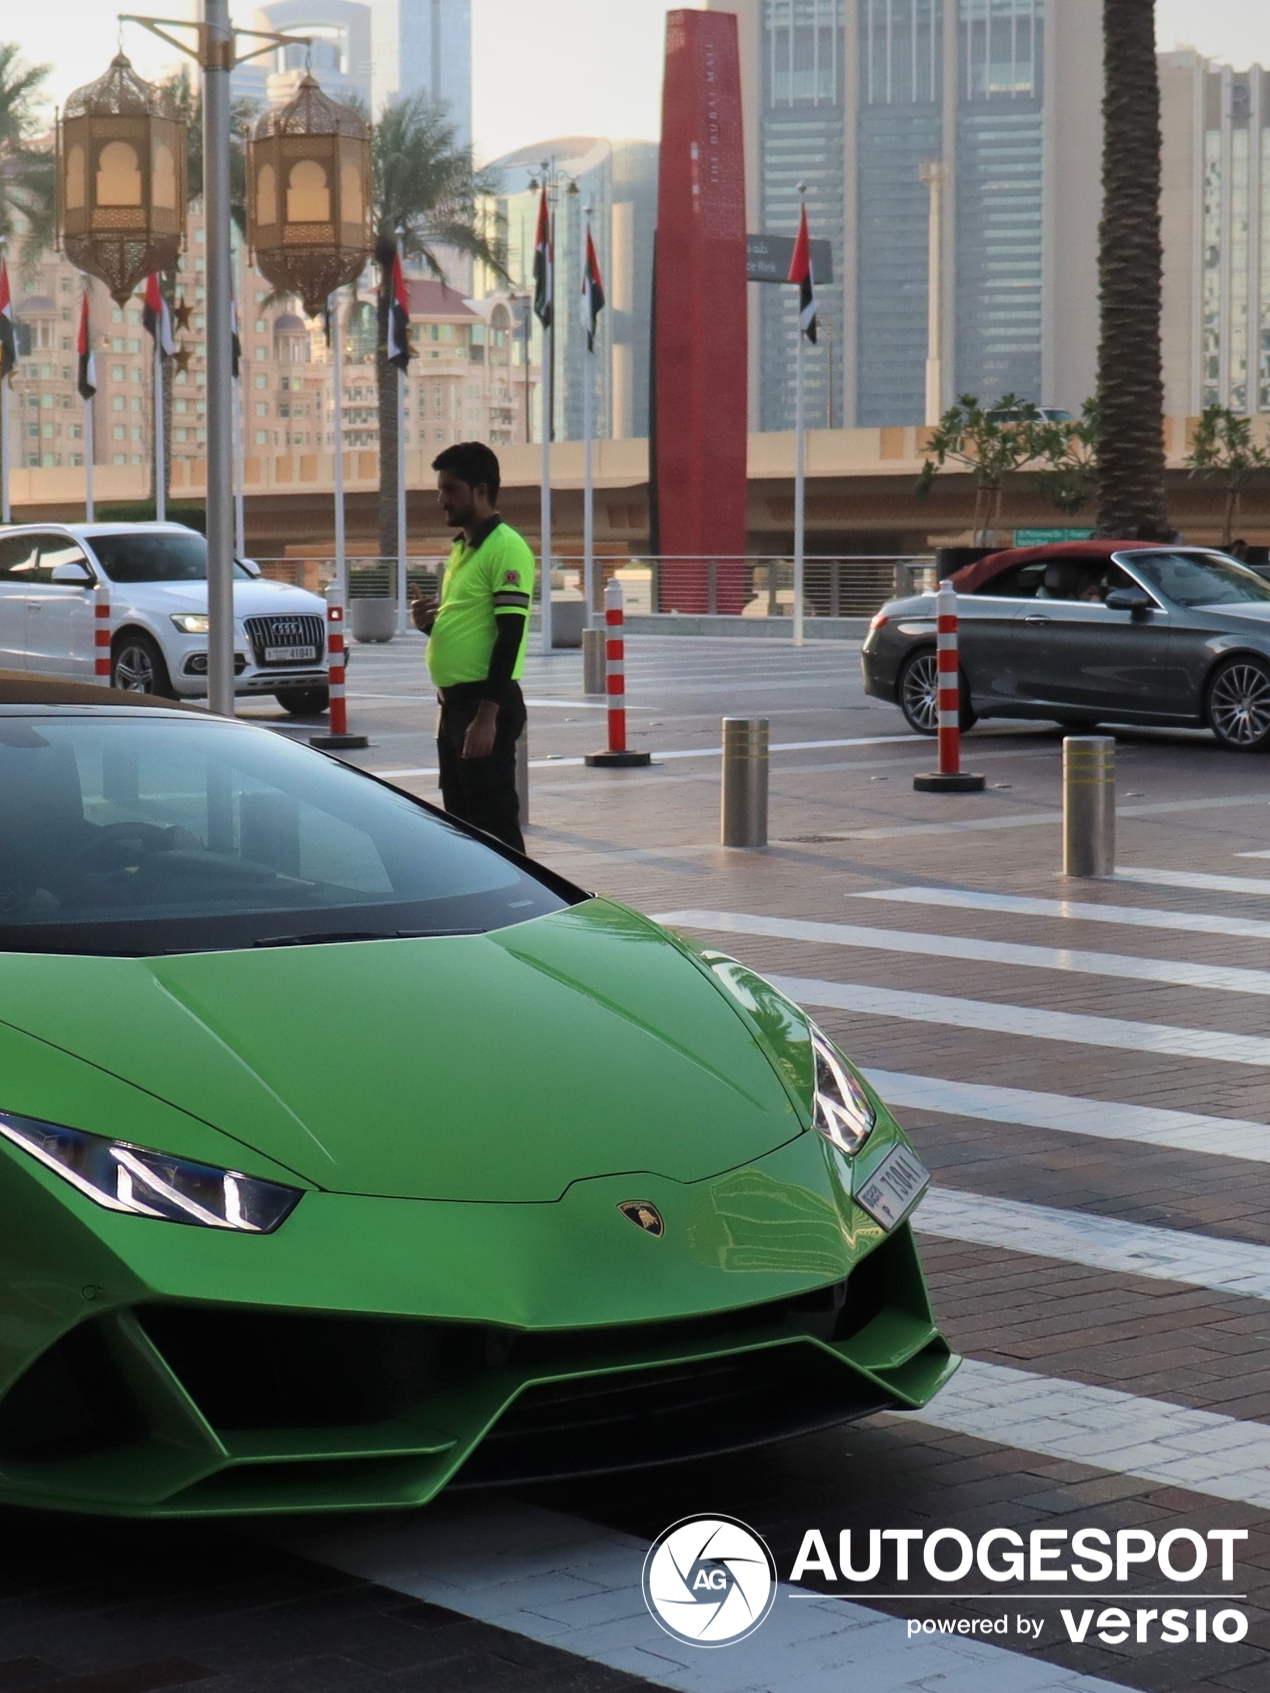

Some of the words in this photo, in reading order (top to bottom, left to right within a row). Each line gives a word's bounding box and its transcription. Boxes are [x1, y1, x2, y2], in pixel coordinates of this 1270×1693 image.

[708, 93, 719, 145] DUBAI
[880, 1155, 922, 1202] 73041
[882, 1205, 895, 1220] P
